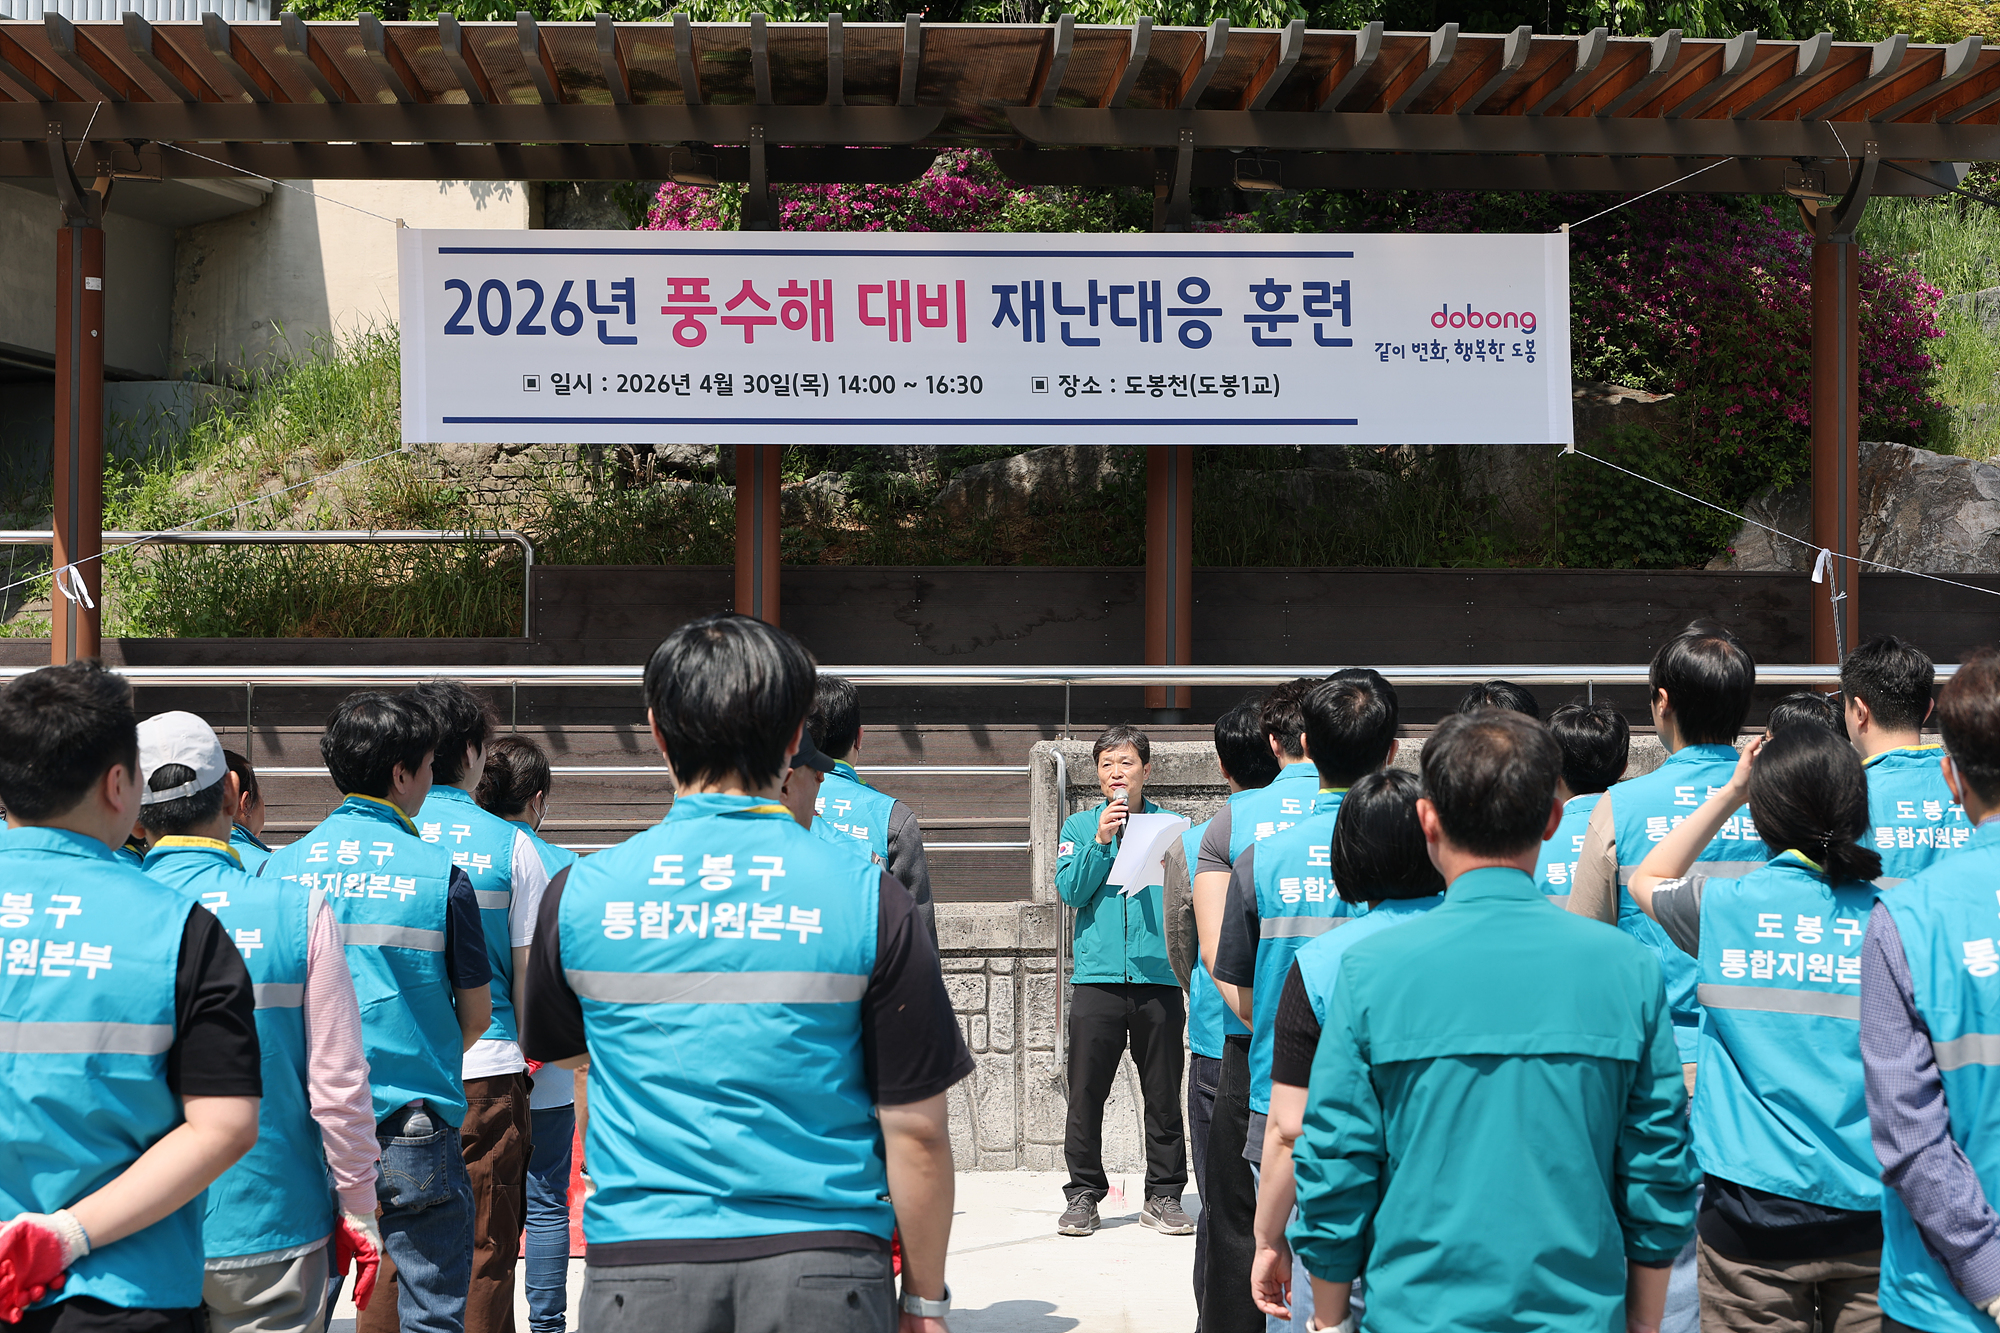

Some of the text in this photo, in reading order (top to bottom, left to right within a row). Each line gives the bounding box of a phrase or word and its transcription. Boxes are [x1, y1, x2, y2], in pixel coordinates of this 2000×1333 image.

[444, 277, 1354, 349] 2026년 풍수해 대비 재난대응 훈련
[1431, 303, 1537, 335] dobong
[1374, 338, 1537, 364] 같이 변화, 행복한 도봉
[550, 372, 592, 396] 일시
[616, 373, 691, 396] 2026년
[699, 373, 734, 397] 4월
[743, 373, 829, 398] 30일(목)
[838, 374, 896, 395] 14:00
[925, 375, 983, 395] 16:30
[1058, 374, 1103, 398] 장소
[1124, 373, 1280, 398] 도봉천(도봉1교)
[1874, 827, 1976, 848] 통합지원본
[281, 872, 417, 902] 합지원본부
[648, 854, 786, 891] 도봉구
[601, 901, 823, 944] 통합지원본부
